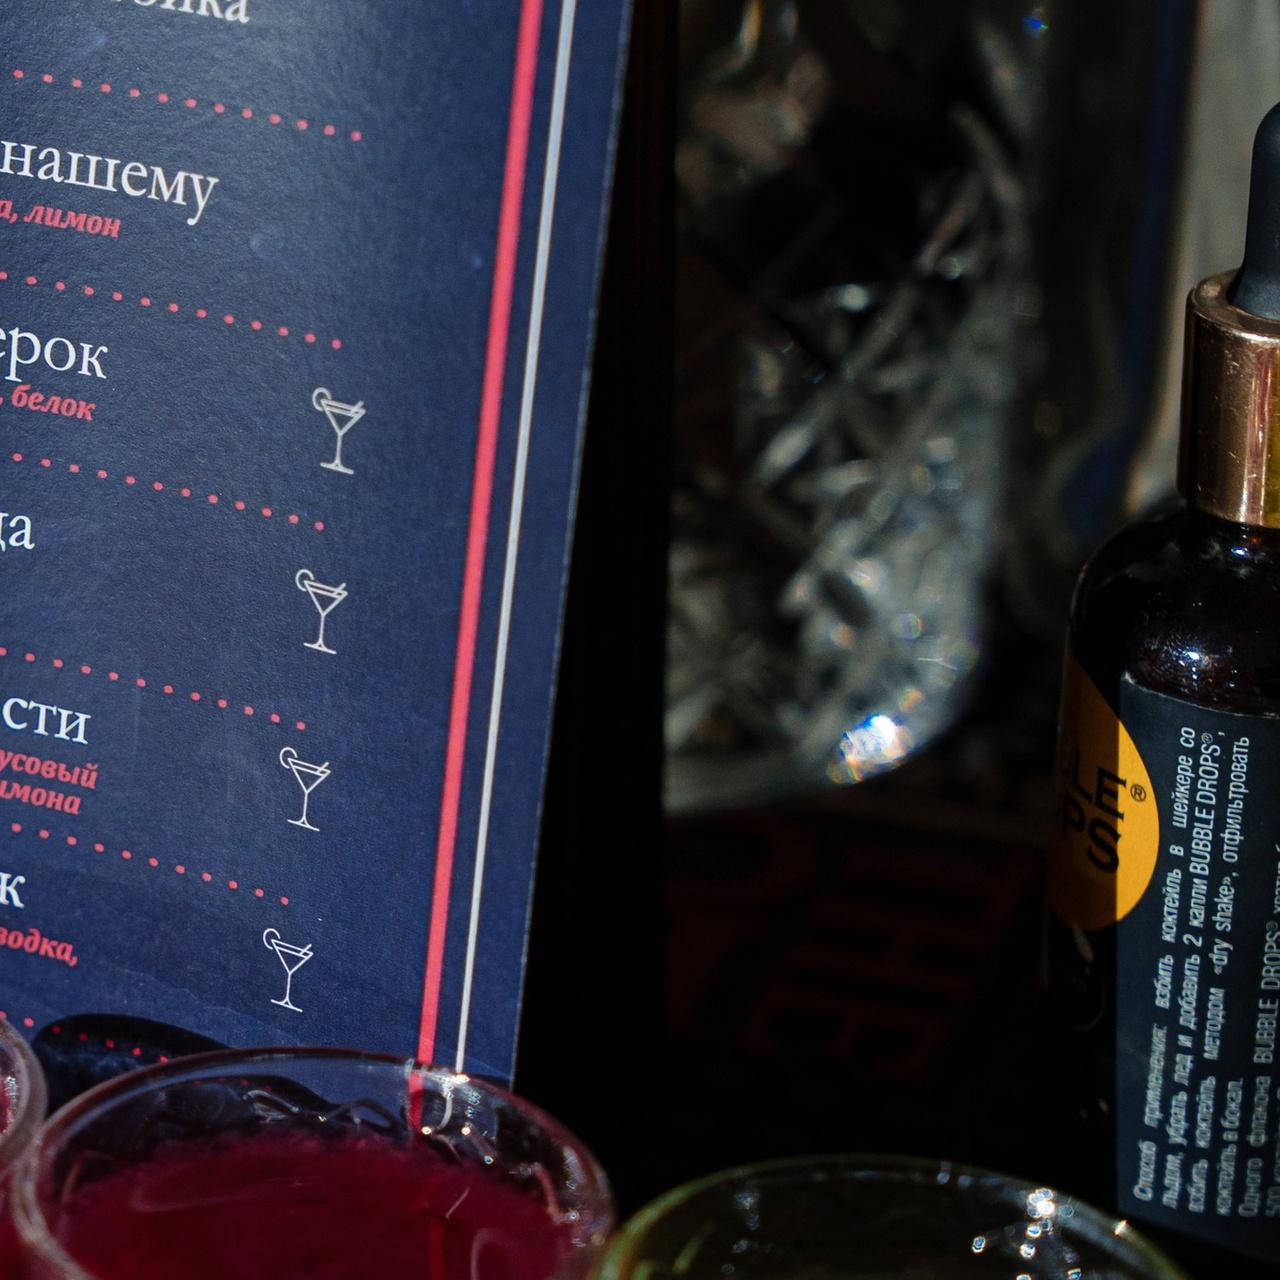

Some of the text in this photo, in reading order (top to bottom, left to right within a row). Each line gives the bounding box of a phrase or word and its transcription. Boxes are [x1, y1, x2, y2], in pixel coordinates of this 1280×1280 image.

[24, 206, 120, 237] лимон
[11, 384, 95, 420] белок
[1189, 806, 1215, 876] BUBBLE
[1189, 878, 1208, 928] капли
[1133, 727, 1196, 1201] Способ применения: взбить коктейль в шейкере со
[1183, 933, 1202, 948] 2
[1178, 955, 1201, 1031] добавить
[1187, 736, 1250, 1213] взбить коктейль методом «dry shake», отфильтровать
[1178, 1035, 1193, 1048] и
[1253, 998, 1279, 1064] BUBBLE
[1174, 1054, 1195, 1086] лед
[1166, 1091, 1189, 1146] убрать
[1162, 1152, 1184, 1209] льдом,
